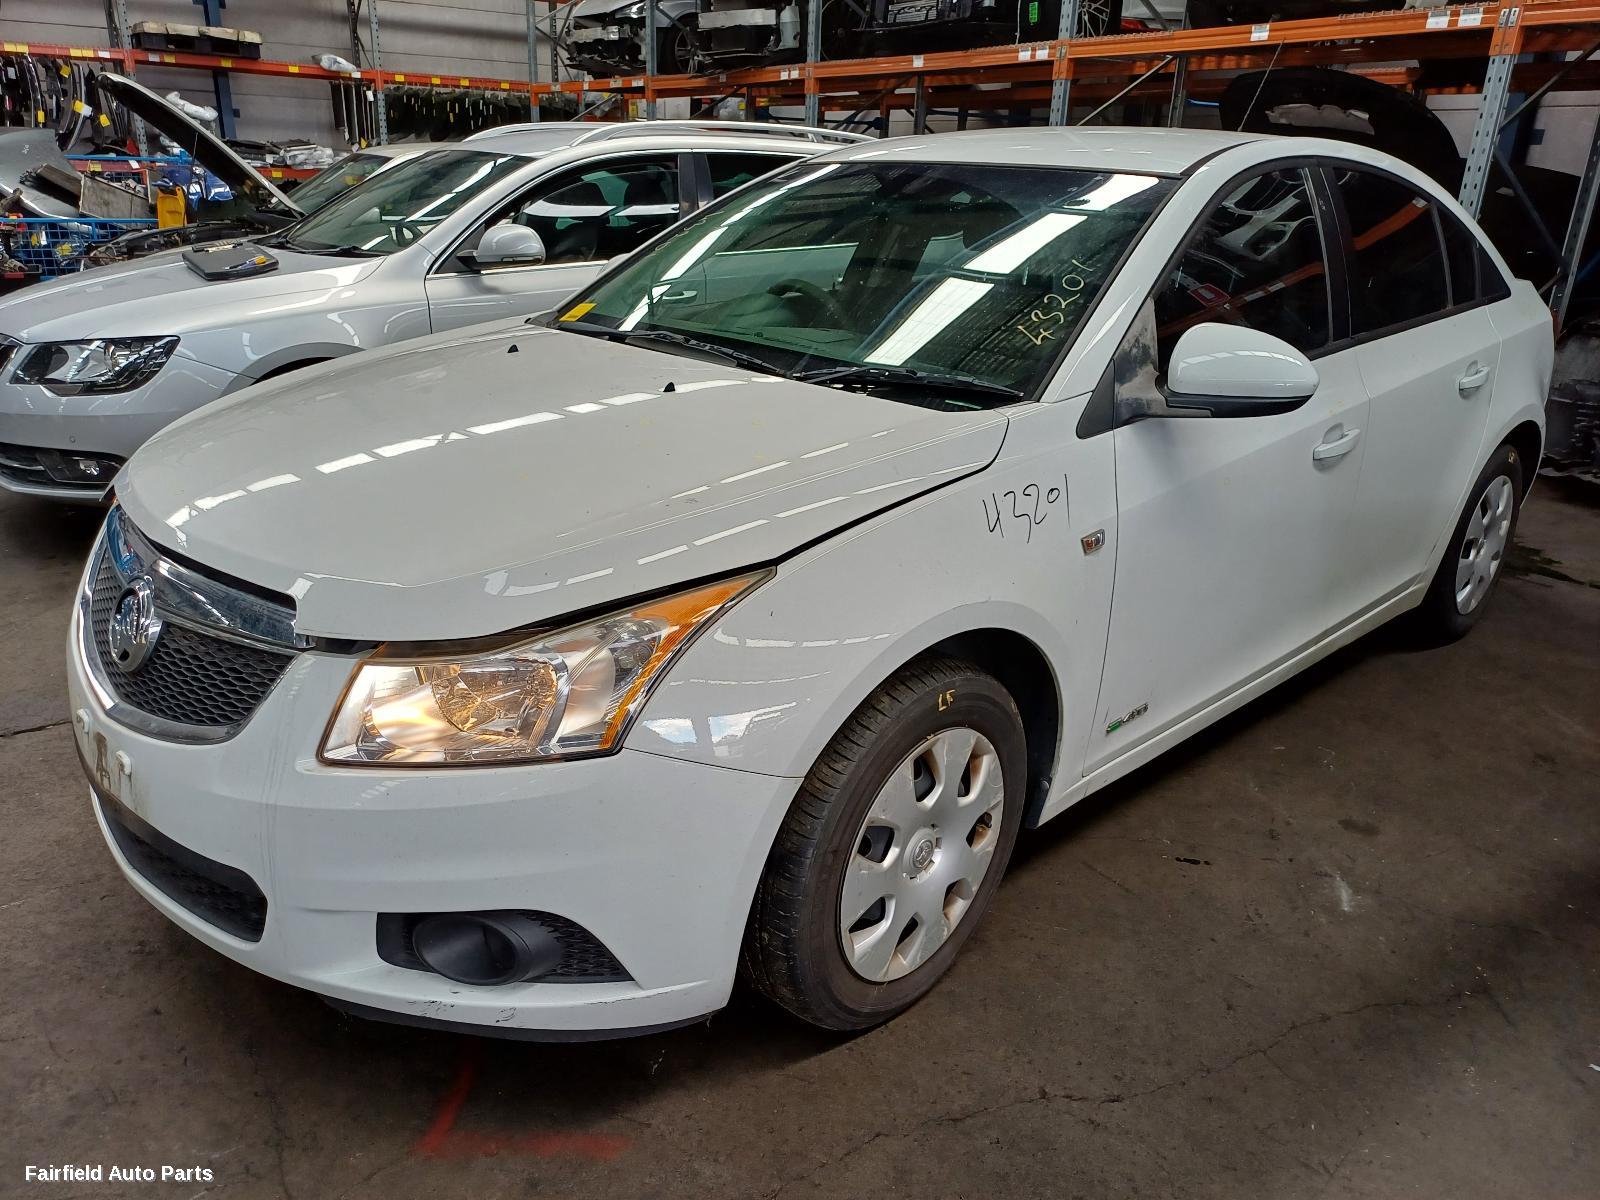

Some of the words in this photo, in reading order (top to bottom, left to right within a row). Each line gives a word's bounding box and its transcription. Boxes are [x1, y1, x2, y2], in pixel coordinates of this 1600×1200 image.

[1017, 258, 1093, 345] 43201
[982, 473, 1070, 544] 43201
[938, 689, 956, 712] LF
